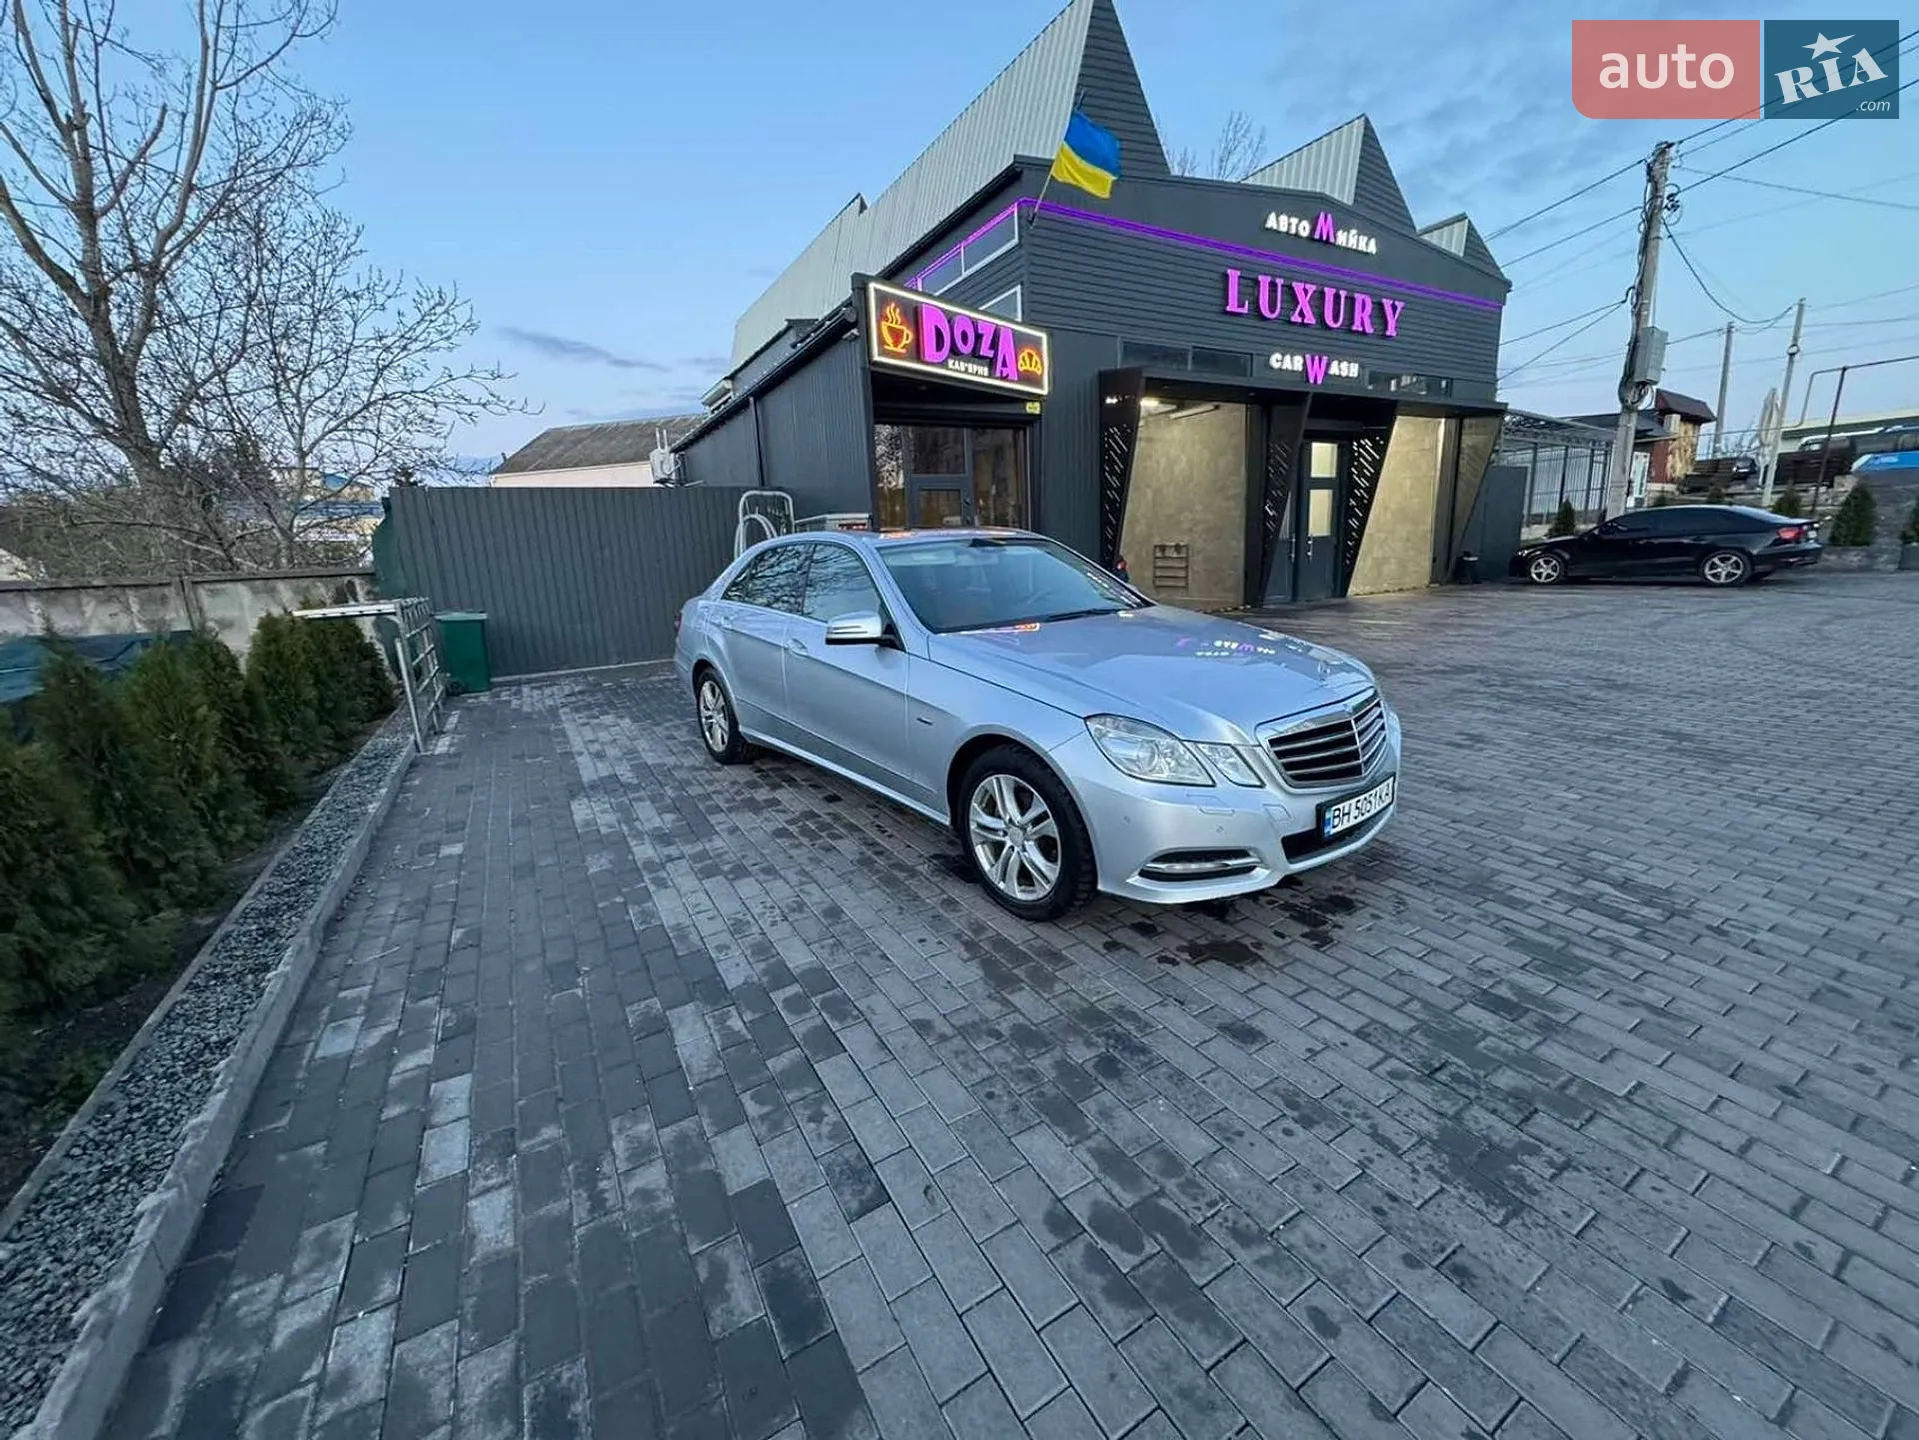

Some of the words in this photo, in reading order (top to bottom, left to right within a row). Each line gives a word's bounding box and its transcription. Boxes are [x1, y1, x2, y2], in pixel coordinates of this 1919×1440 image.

[1264, 211, 1311, 238] АВТО
[1226, 268, 1405, 337] LUXURY
[919, 303, 1018, 381] DOZA
